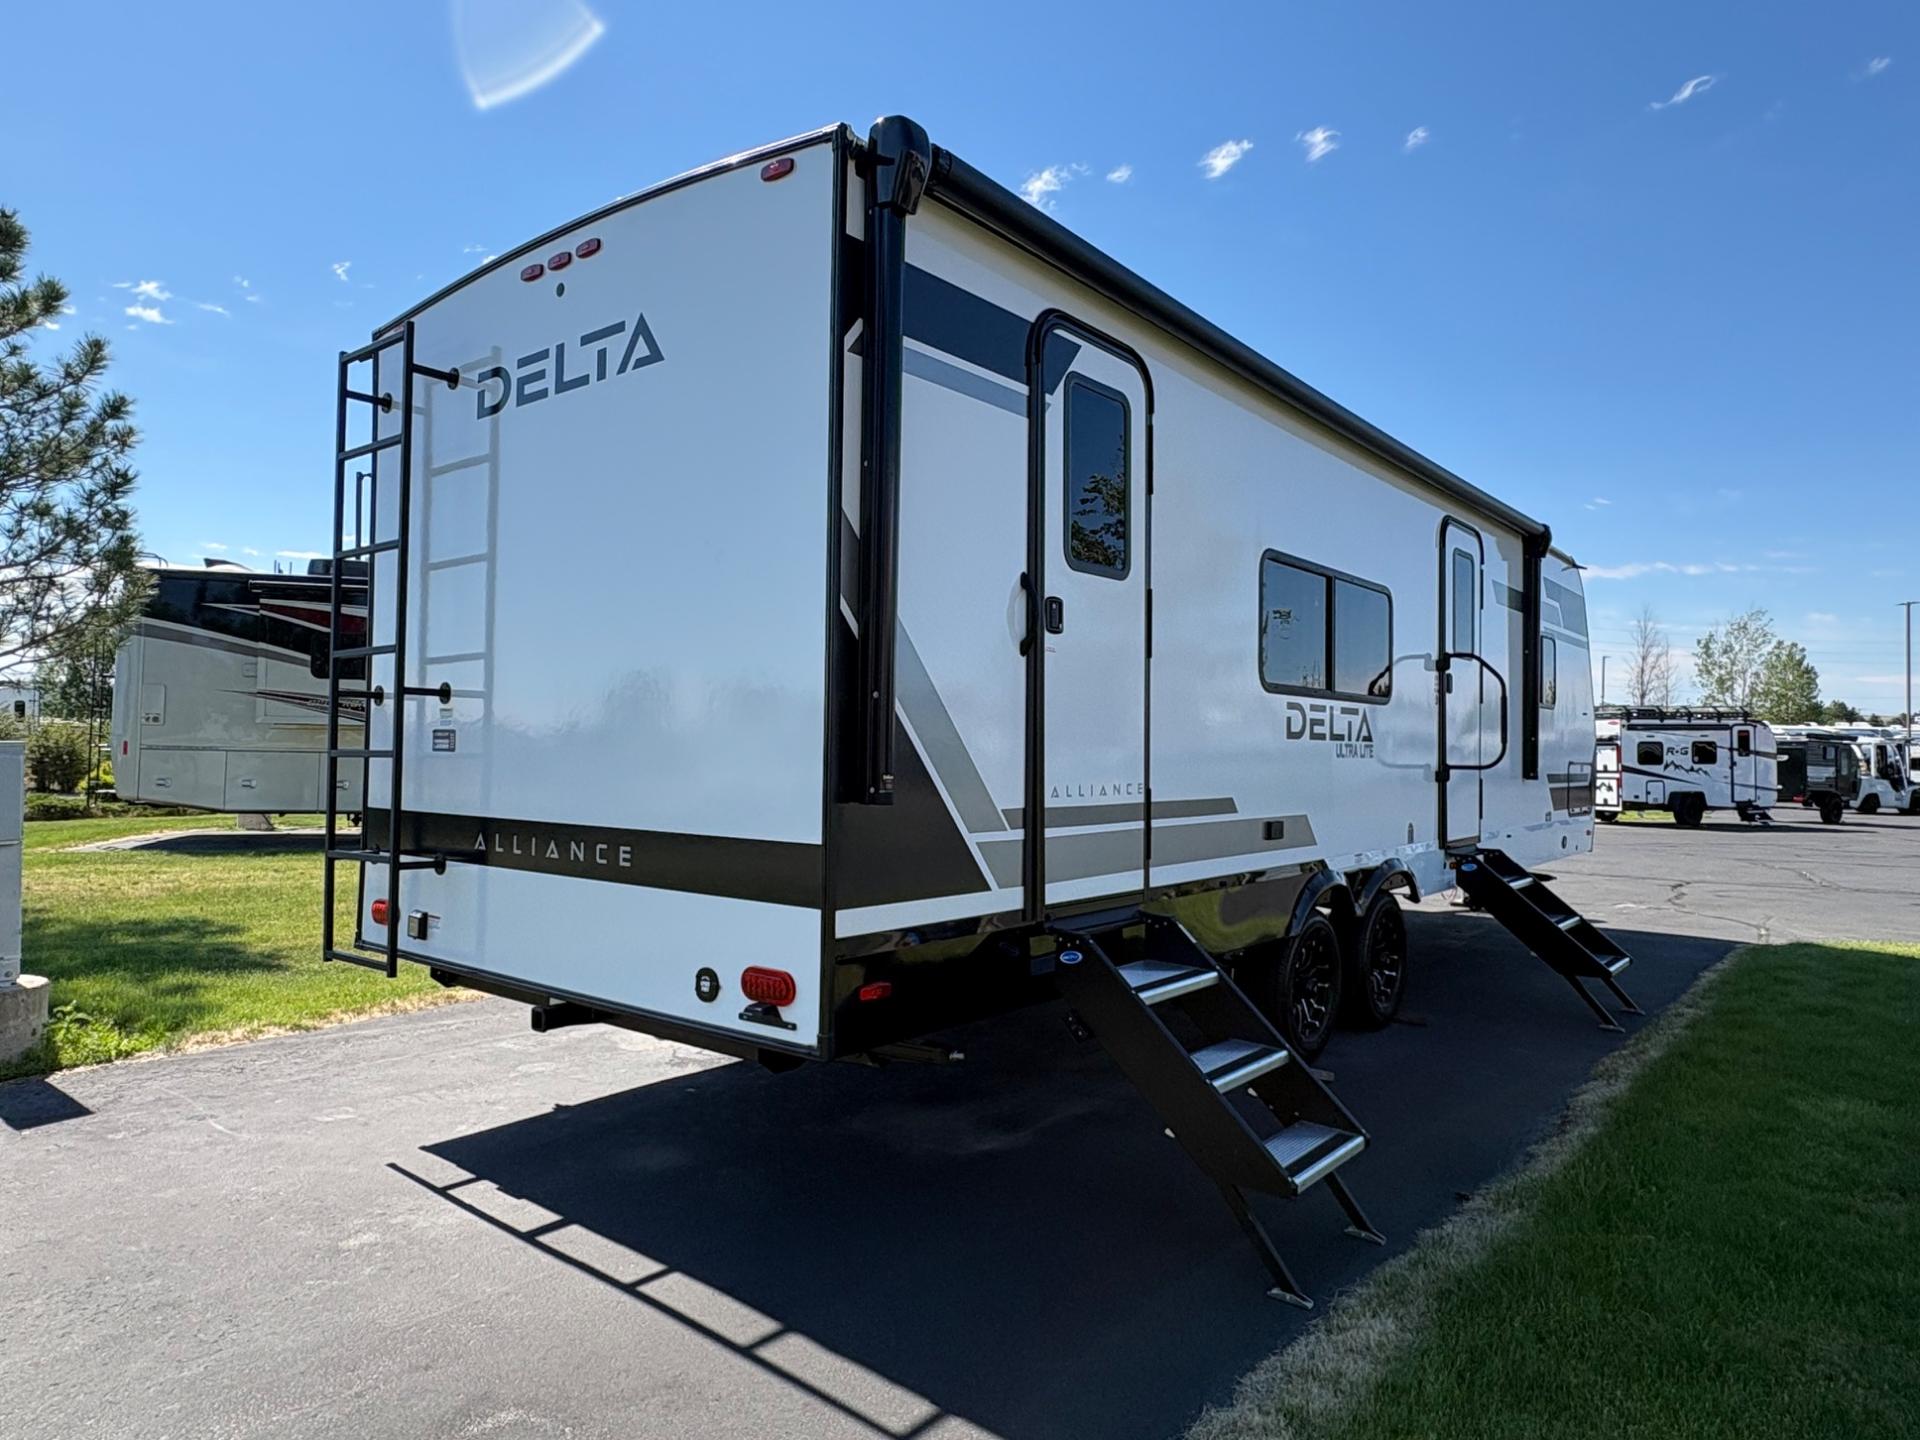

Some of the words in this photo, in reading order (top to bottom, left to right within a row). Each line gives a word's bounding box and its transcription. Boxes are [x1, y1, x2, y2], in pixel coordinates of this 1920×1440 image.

[476, 312, 665, 420] DELTA
[1286, 701, 1373, 742] DELTA
[1050, 783, 1143, 798] ALLIANCE
[473, 832, 632, 868] ALLIANCE
